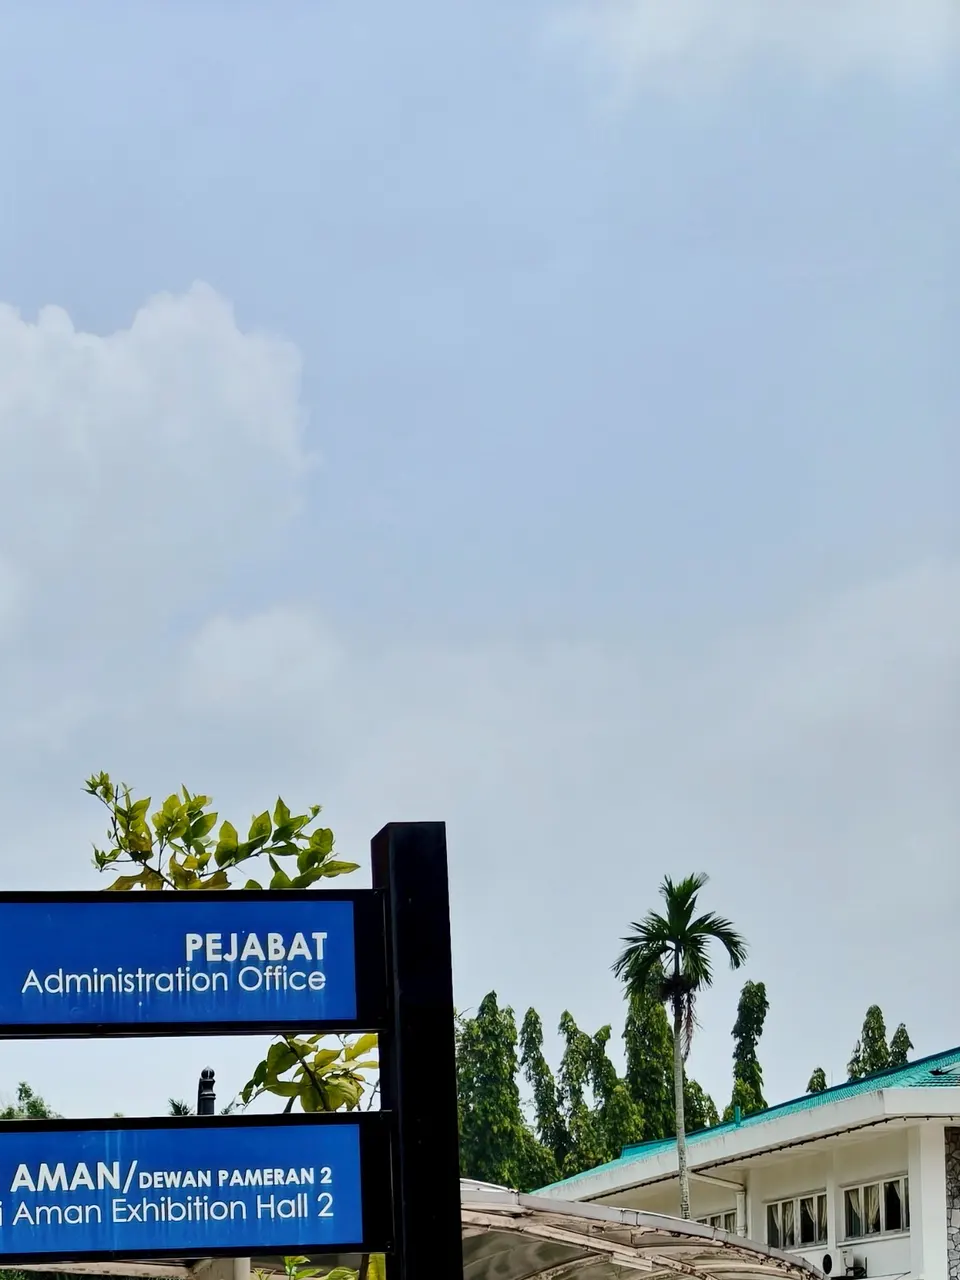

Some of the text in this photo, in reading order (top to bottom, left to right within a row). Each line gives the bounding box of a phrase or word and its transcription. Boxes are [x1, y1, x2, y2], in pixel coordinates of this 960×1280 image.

[185, 932, 328, 963] PEJABAT
[21, 965, 327, 994] Administration Office
[217, 1167, 315, 1187] PAMERAN
[320, 1166, 333, 1185] 2
[12, 1201, 102, 1227] Aman
[111, 1195, 247, 1223] Exhibition
[256, 1193, 309, 1219] Hall
[316, 1192, 335, 1218] 2
